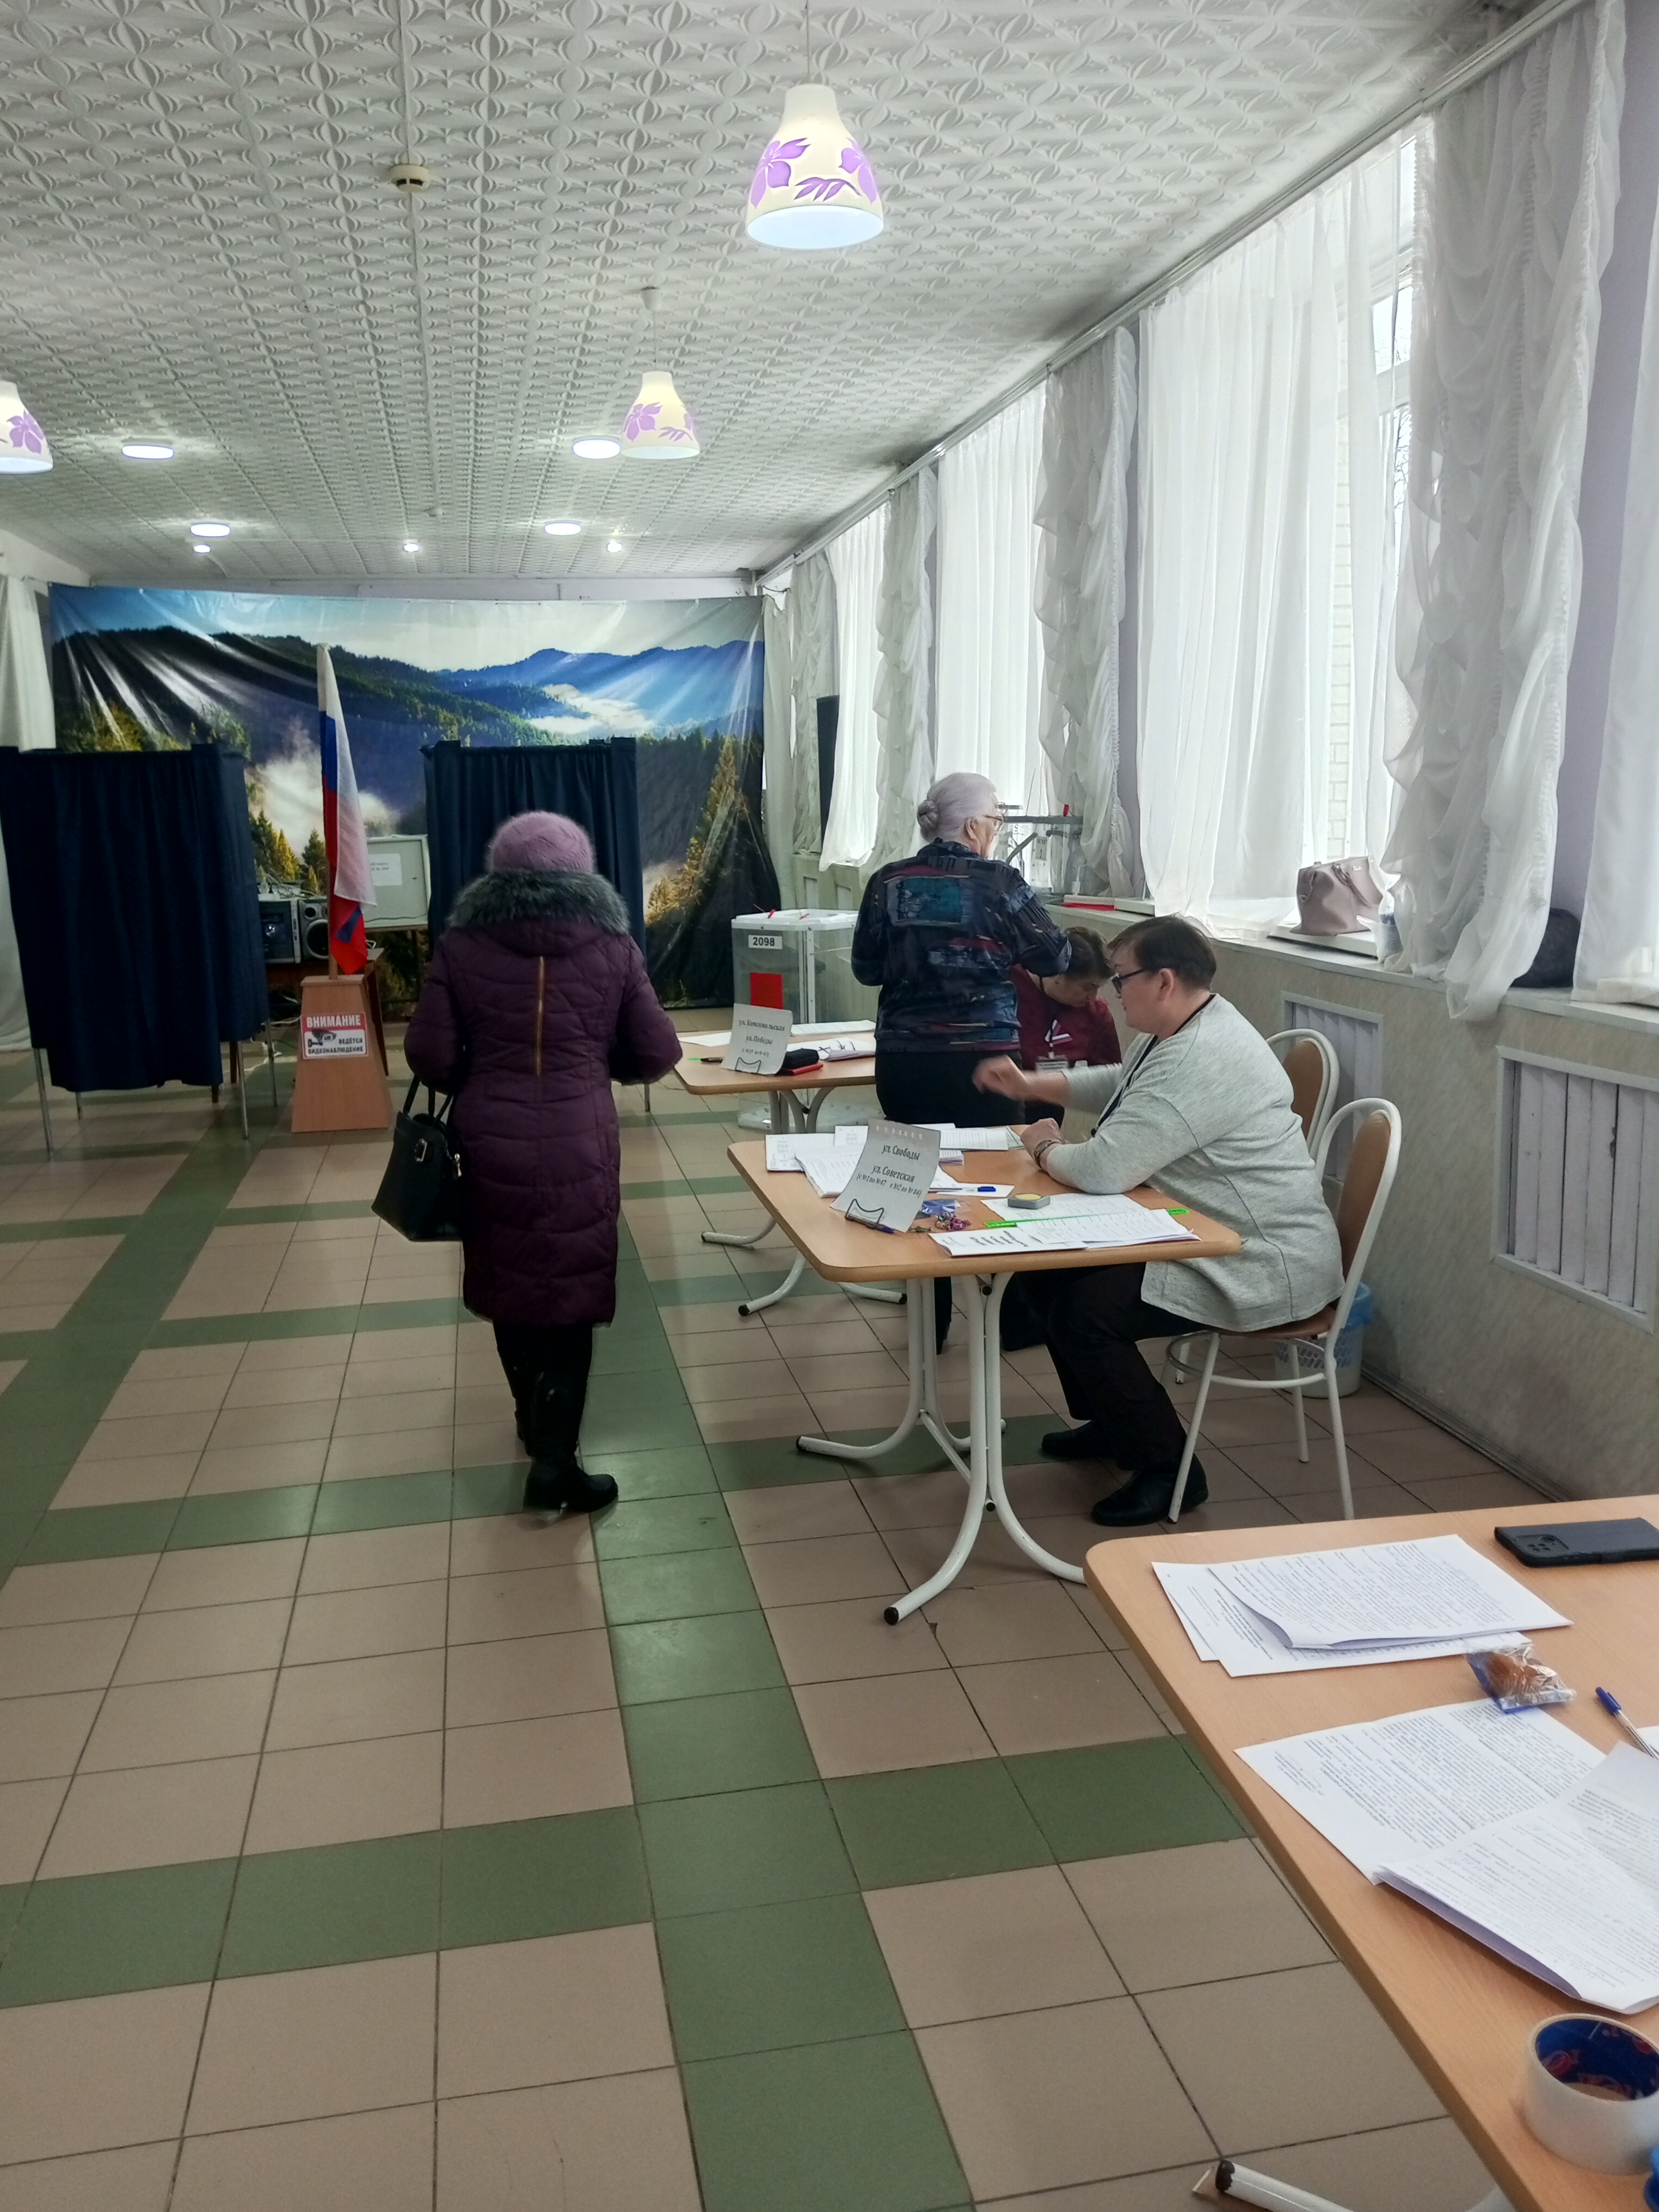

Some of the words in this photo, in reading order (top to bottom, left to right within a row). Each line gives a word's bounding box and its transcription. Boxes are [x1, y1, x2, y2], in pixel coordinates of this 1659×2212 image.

[752, 937, 775, 947] 2098
[306, 1015, 361, 1028] ВНИМАНИЕ
[308, 1046, 363, 1054] ВИДЕОНАБЛЮДЕНИЕ
[882, 1145, 890, 1154] ул.
[893, 1145, 920, 1160] Свободы
[871, 1165, 881, 1174] ул.
[882, 1166, 915, 1183] Советская
